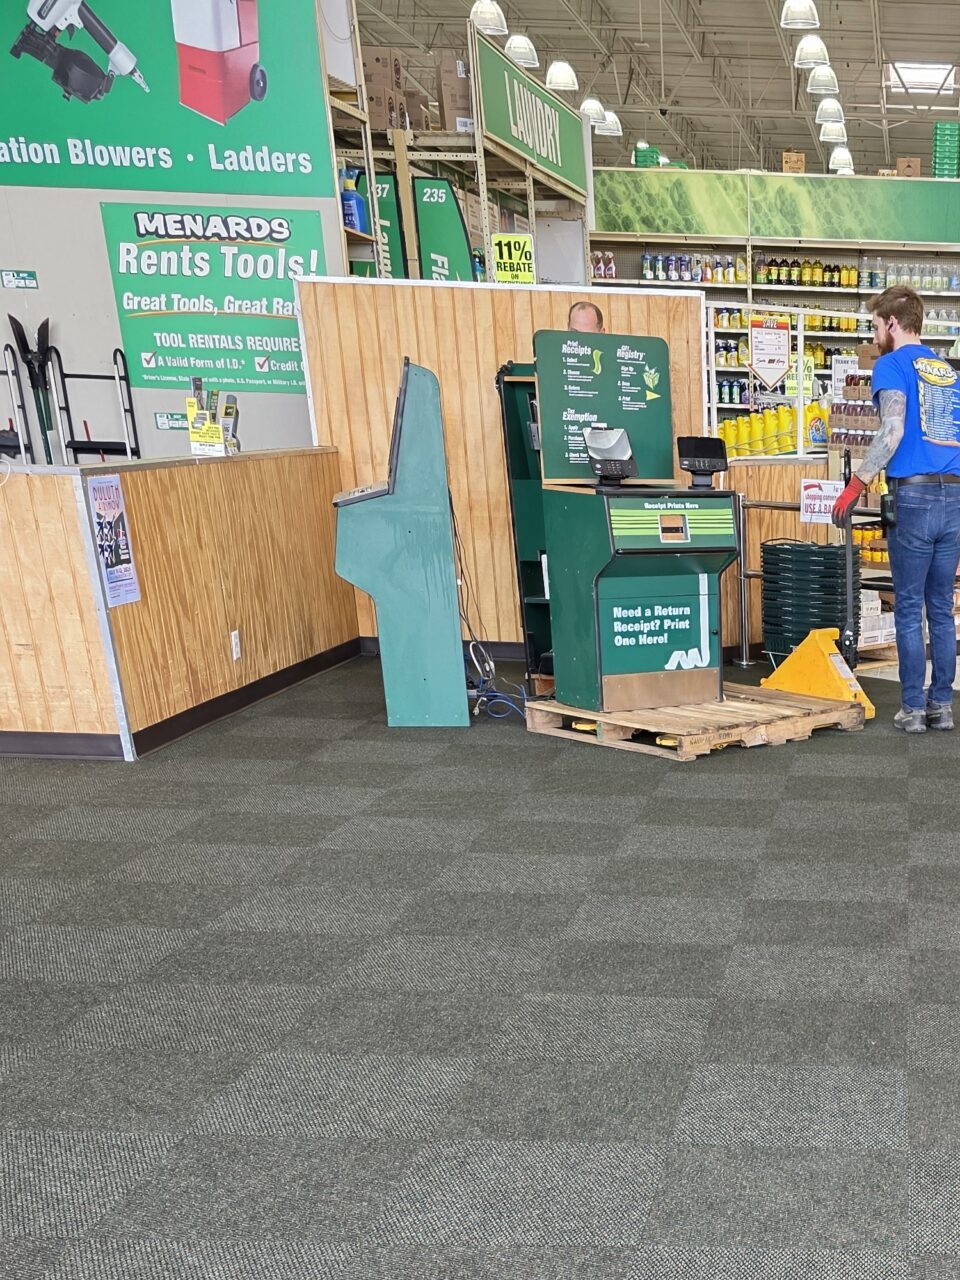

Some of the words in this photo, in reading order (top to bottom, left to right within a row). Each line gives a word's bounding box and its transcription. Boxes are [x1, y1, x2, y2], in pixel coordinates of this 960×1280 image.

[505, 71, 563, 167] LAUNDRY
[0, 136, 61, 164] ation
[67, 138, 174, 168] Blowers
[208, 143, 313, 173] Ladders
[367, 183, 390, 198] 37
[422, 187, 446, 203] 235
[135, 211, 292, 241] MENARDS
[493, 241, 532, 262] 11%
[118, 242, 211, 277] Rents
[220, 245, 318, 279] Tools!
[429, 252, 450, 281] Fla
[496, 262, 533, 273] REBATE
[122, 292, 168, 311] Great
[171, 293, 218, 316] Tools,
[223, 295, 268, 314] Great
[271, 297, 298, 316] Rat
[762, 318, 778, 328] SAVE
[154, 332, 187, 349] TOOL
[188, 333, 244, 351] RENTALS
[562, 344, 592, 357] Receipts
[616, 349, 645, 361] Registry
[157, 355, 164, 366] A
[164, 355, 188, 367] Valid
[190, 357, 213, 369] Form
[215, 358, 225, 368] of
[270, 360, 295, 371] Credit
[562, 411, 598, 423] Exemption
[567, 407, 576, 415] Tax
[643, 503, 665, 511] Receipt
[804, 503, 816, 514] USE
[613, 606, 641, 618] Need
[645, 609, 652, 617] a
[654, 605, 691, 616] Return
[613, 619, 660, 634] Receipt?
[663, 618, 690, 630] Print
[614, 635, 636, 646] One
[638, 633, 668, 645] Here!
